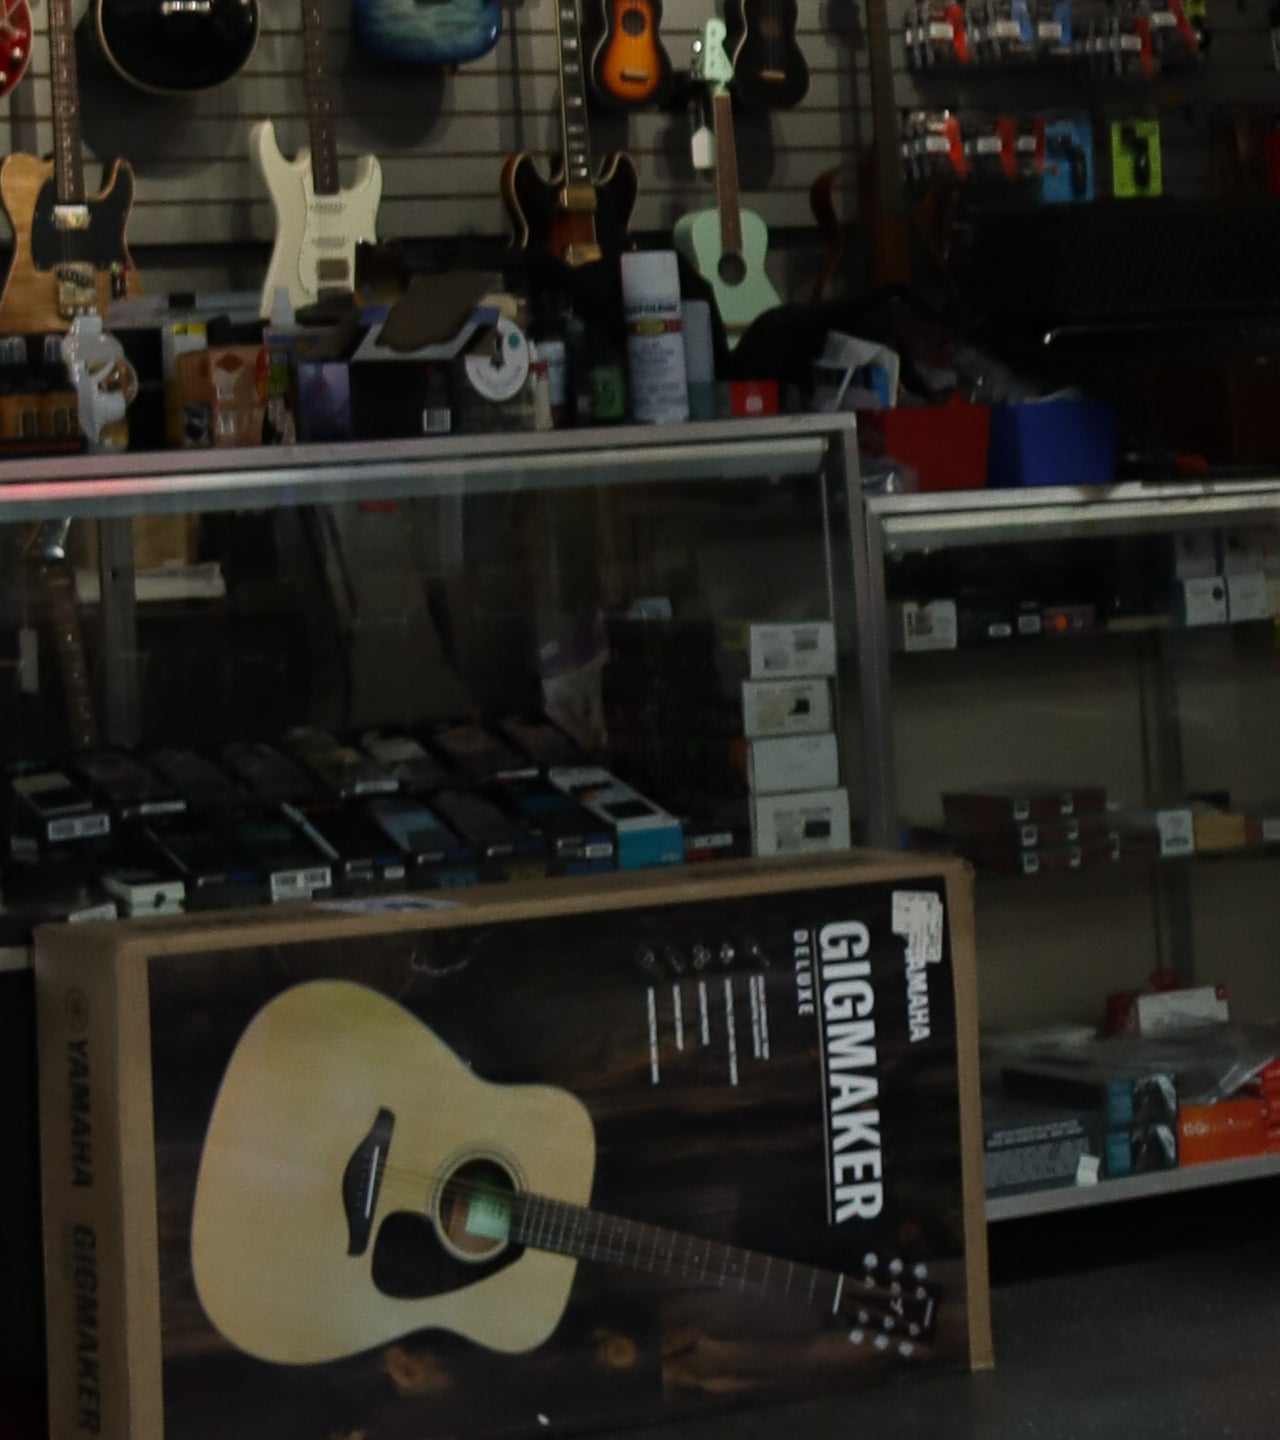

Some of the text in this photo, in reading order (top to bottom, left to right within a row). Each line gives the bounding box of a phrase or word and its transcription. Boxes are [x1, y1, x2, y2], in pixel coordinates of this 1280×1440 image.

[791, 927, 816, 1018] DELUXE
[903, 946, 932, 1044] AMAHA
[66, 1038, 94, 1189] YAMAHA
[820, 919, 885, 1225] GIGMAKER
[71, 1223, 102, 1437] GIGMAKER
